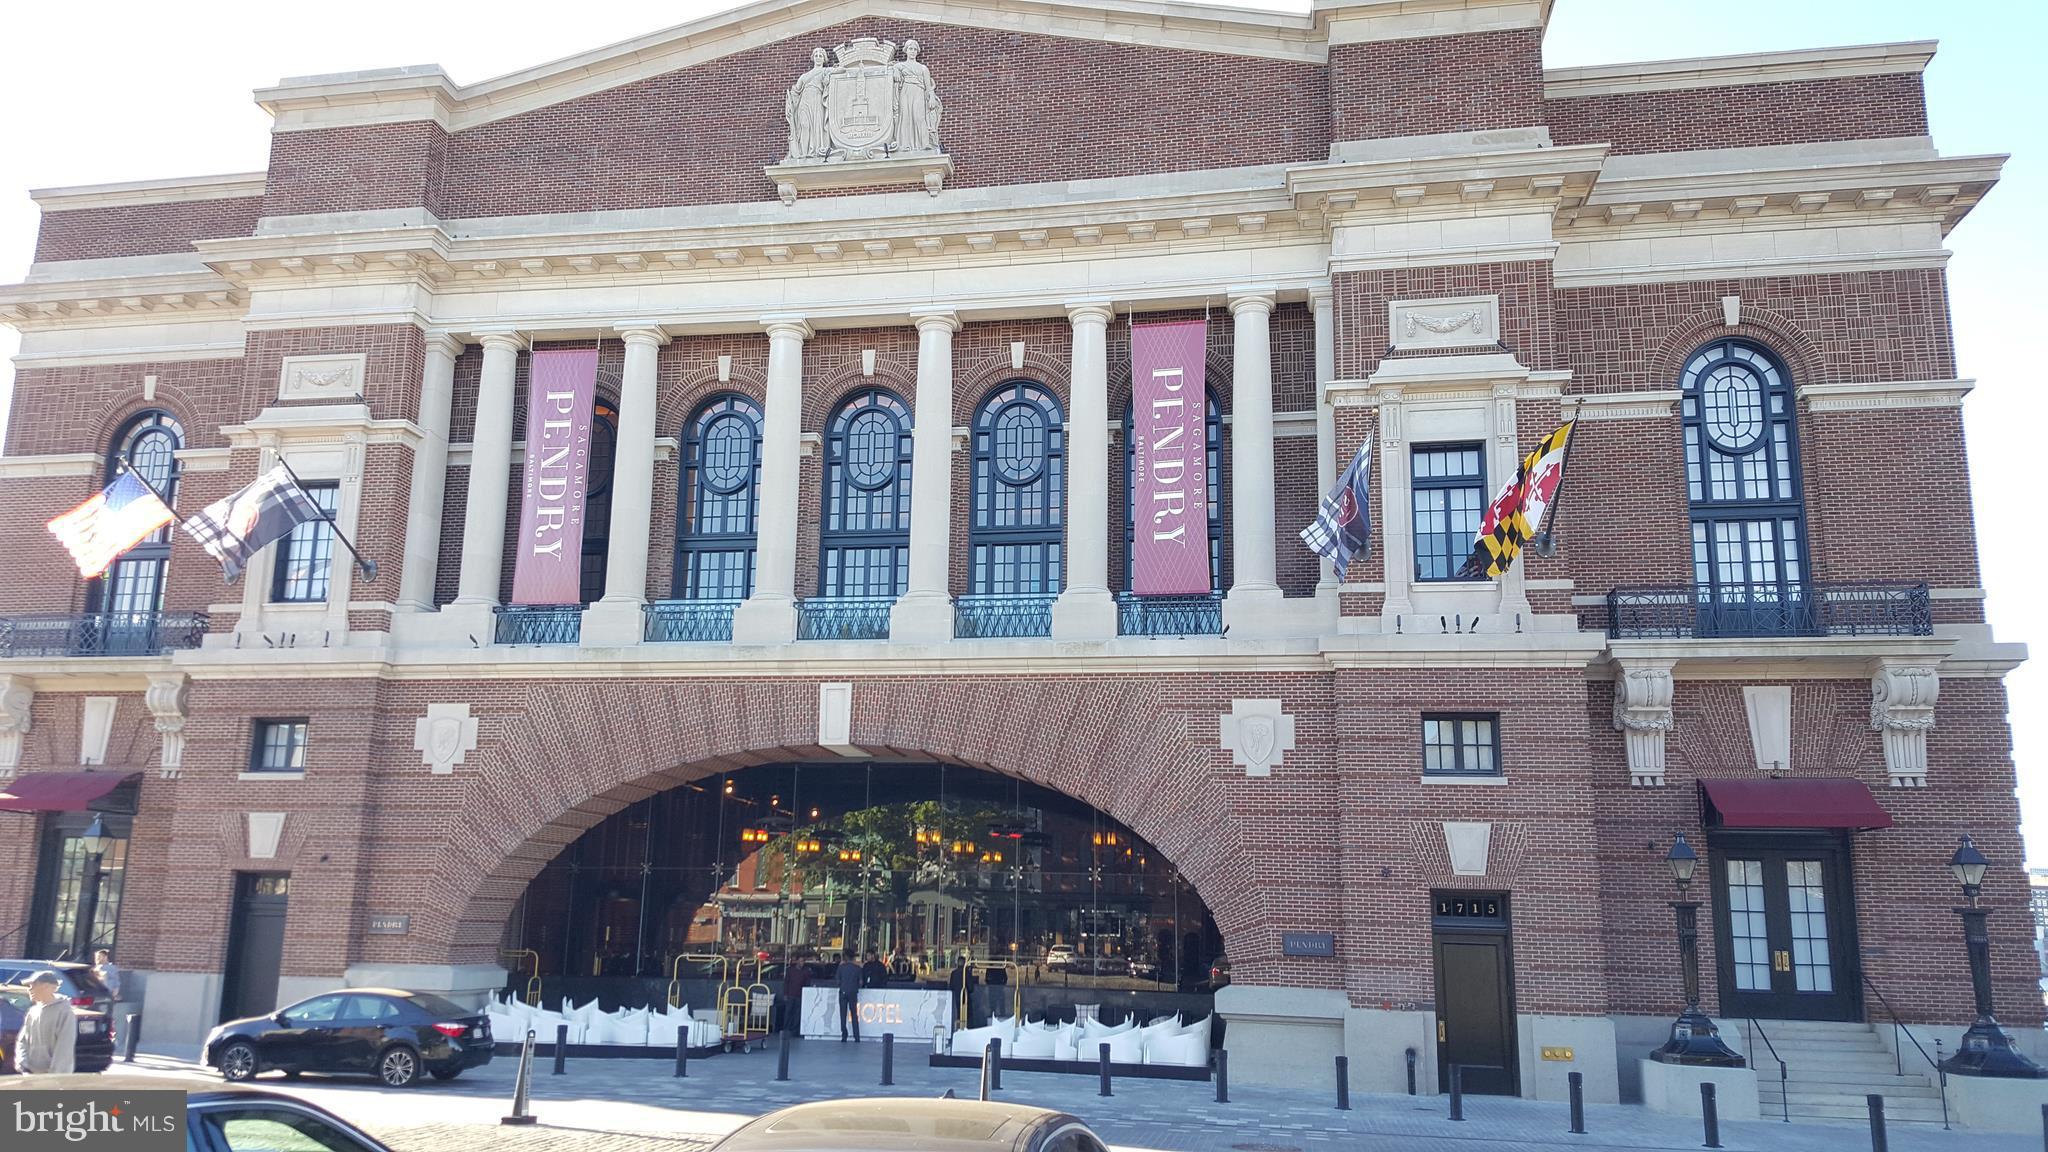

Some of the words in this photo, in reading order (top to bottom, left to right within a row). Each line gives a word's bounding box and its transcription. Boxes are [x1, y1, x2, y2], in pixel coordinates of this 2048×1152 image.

[526, 453, 535, 499] BALTIMORE
[533, 390, 575, 562] PENDRY
[570, 424, 588, 526] SAGAMORE
[1152, 365, 1186, 548] PENDRY
[1192, 402, 1203, 510] SAGAMORE
[1440, 903, 1495, 914] 1715
